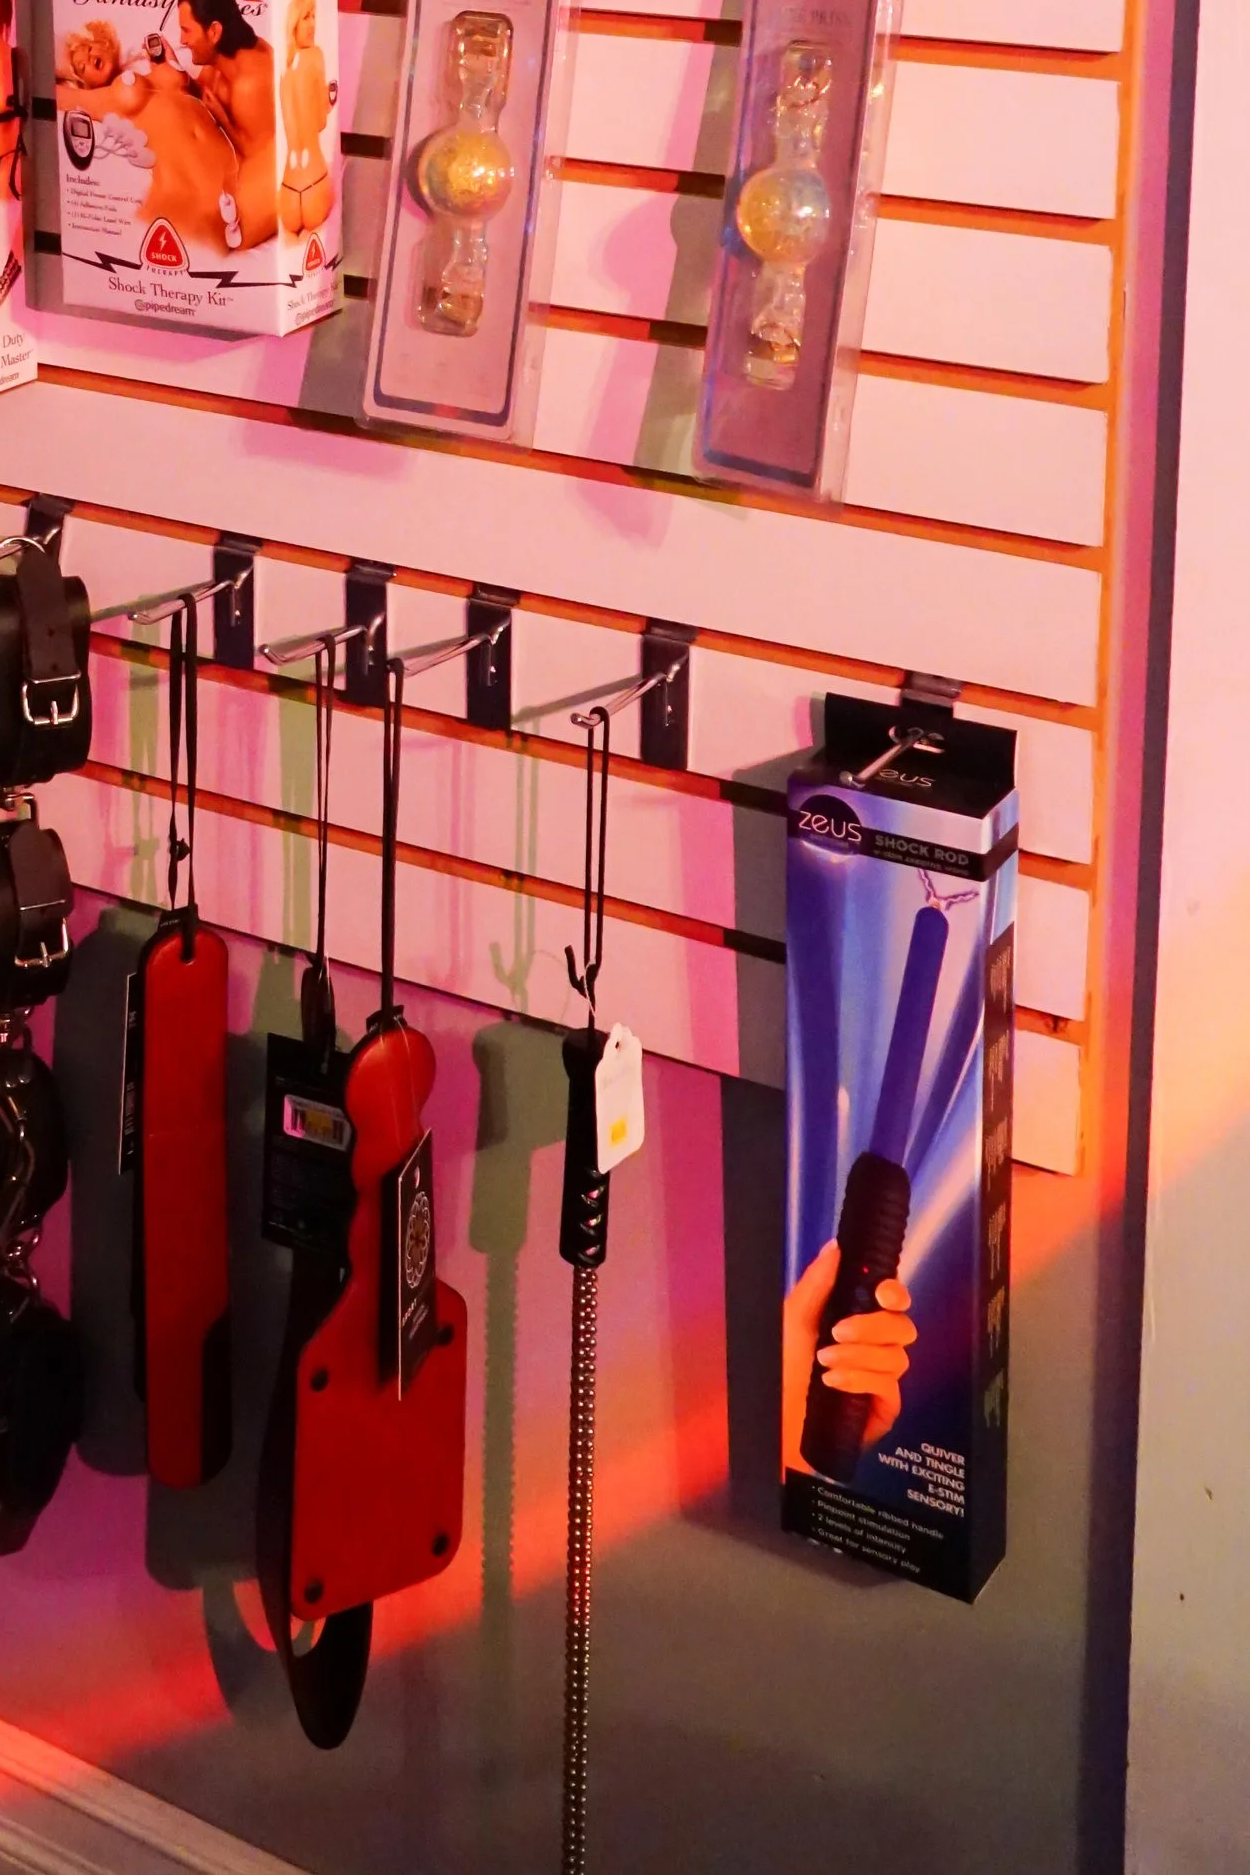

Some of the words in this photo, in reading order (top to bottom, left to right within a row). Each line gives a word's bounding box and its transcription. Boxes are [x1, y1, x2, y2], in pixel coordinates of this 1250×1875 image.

[151, 251, 178, 263] SHOCK
[109, 277, 146, 296] Shock
[150, 283, 203, 306] Therapy
[207, 292, 228, 306] Kit
[3, 332, 26, 350] Duty
[1, 350, 31, 368] Master
[879, 767, 935, 787] eus
[874, 834, 930, 857] SHOCK
[933, 847, 969, 866] ROD
[895, 1446, 923, 1464] AND
[925, 1457, 965, 1479] TINGLE
[920, 1442, 965, 1466] QUIVER
[878, 1452, 909, 1473] WITH
[912, 1465, 965, 1492] EXCITING
[907, 1489, 964, 1518] SENSORY!
[928, 1484, 965, 1505] E-STIM
[817, 1487, 876, 1515] Comfortable
[878, 1510, 909, 1527] ribbed
[912, 1521, 944, 1540] handle
[817, 1500, 856, 1522] Pinpoint
[859, 1514, 910, 1541] stimulation
[817, 1513, 823, 1522] 2
[826, 1517, 852, 1533] levels
[855, 1528, 864, 1536] of
[866, 1532, 907, 1554] intensity
[817, 1528, 843, 1543] Great
[846, 1537, 860, 1549] for
[862, 1544, 899, 1565] sensory
[901, 1559, 921, 1574] play
